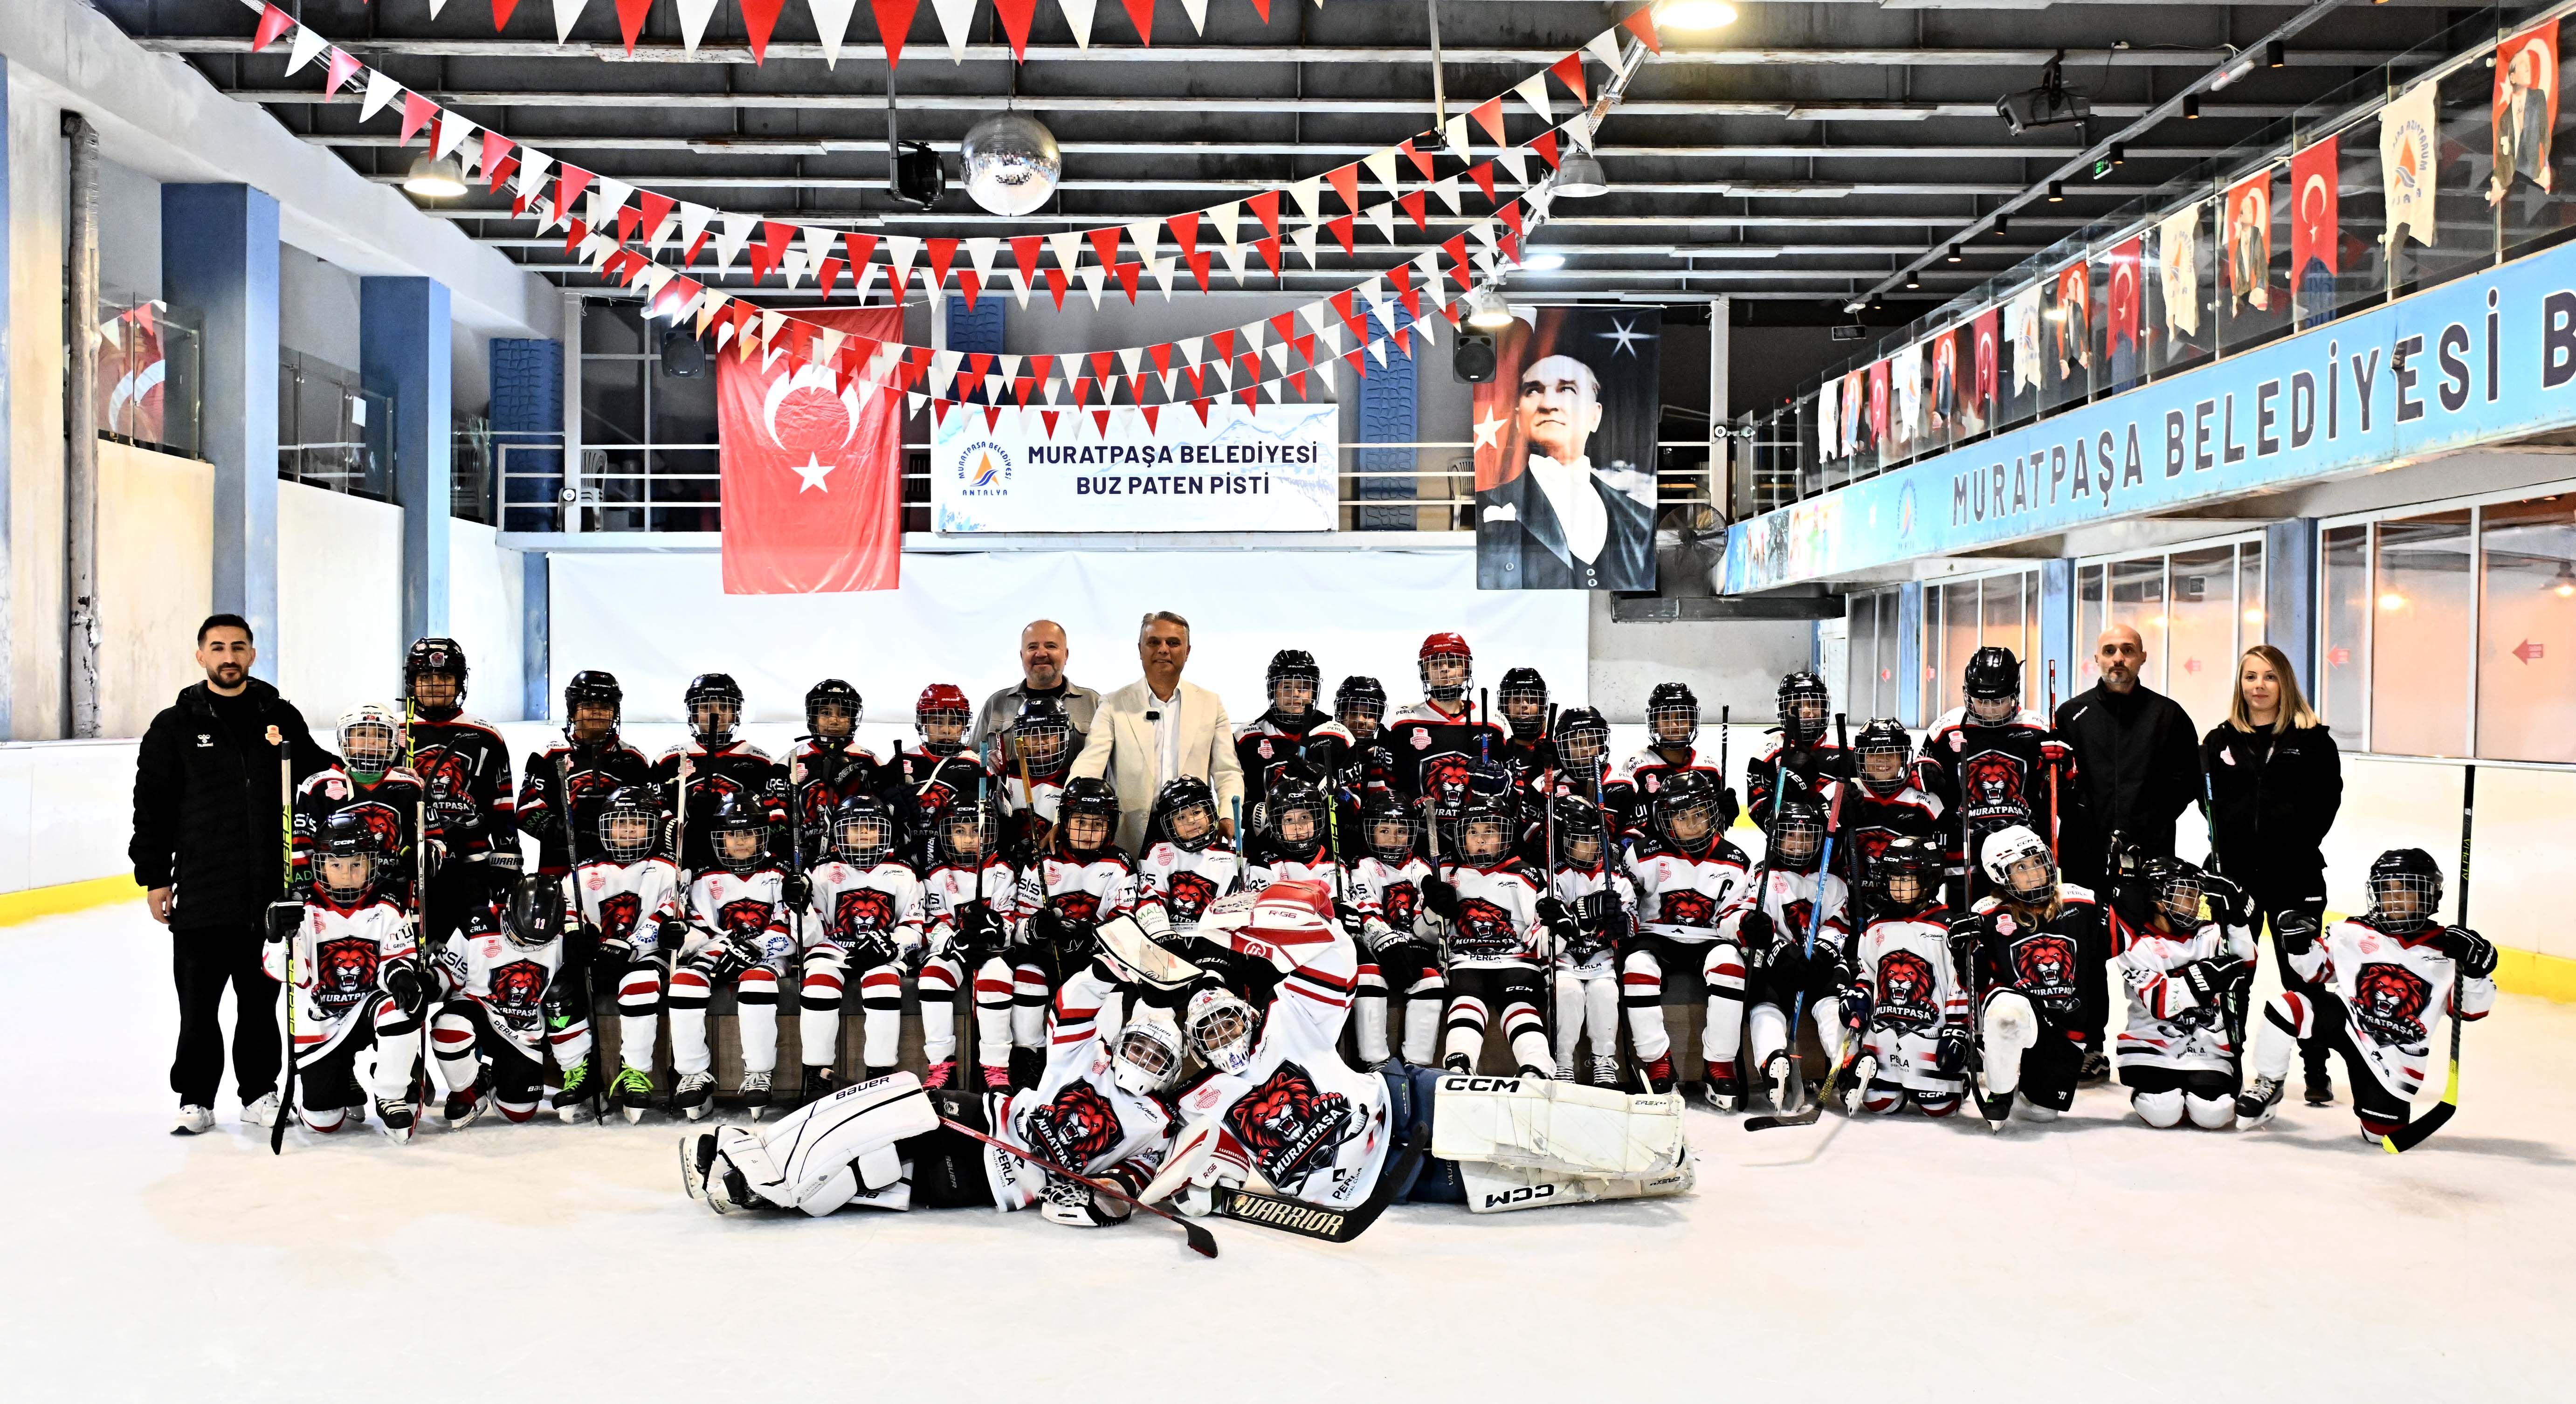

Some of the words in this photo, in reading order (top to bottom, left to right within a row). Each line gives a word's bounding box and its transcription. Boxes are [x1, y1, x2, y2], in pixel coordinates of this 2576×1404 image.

[1952, 421, 2144, 528] MURATPAŞA
[2165, 287, 2500, 479] BELEDİYESİ
[958, 441, 985, 479] MURATPAŞA
[1029, 446, 1173, 468] MURATPAŞA
[1181, 441, 1316, 463] BELEDİYESİ
[1077, 477, 1121, 495] BUZ
[1129, 477, 1203, 494] PATEN
[1211, 472, 1269, 494] PİSTİ
[474, 720, 494, 730] PERLA
[1629, 759, 1645, 771] PERLA
[1969, 805, 2024, 818] MURATPAŞA
[1644, 845, 1662, 853] PERLA
[2017, 839, 2033, 847] CCM
[2462, 839, 2470, 881] ALPHA
[1521, 869, 1538, 883] PERLA
[381, 893, 400, 907] PERLA
[535, 918, 545, 929] 11
[1874, 1005, 1931, 1021] MURATPAŞA
[494, 1020, 519, 1040] PERLA
[1147, 1022, 1171, 1037] BAUER
[836, 1077, 890, 1101] BAUER
[1446, 1078, 1520, 1093] CCM
[944, 1121, 976, 1137] WARRIOR
[1272, 1109, 1343, 1181] MURATPAŞA
[1219, 1147, 1249, 1164] WARRIOR
[945, 1155, 957, 1189] BAUER
[996, 1148, 1016, 1185] PERLA
[998, 1170, 1006, 1188] CLINICS
[1343, 1184, 1355, 1201] DENTAL
[1485, 1184, 1555, 1208] CCM
[1237, 1197, 1344, 1235] WARRIOR
